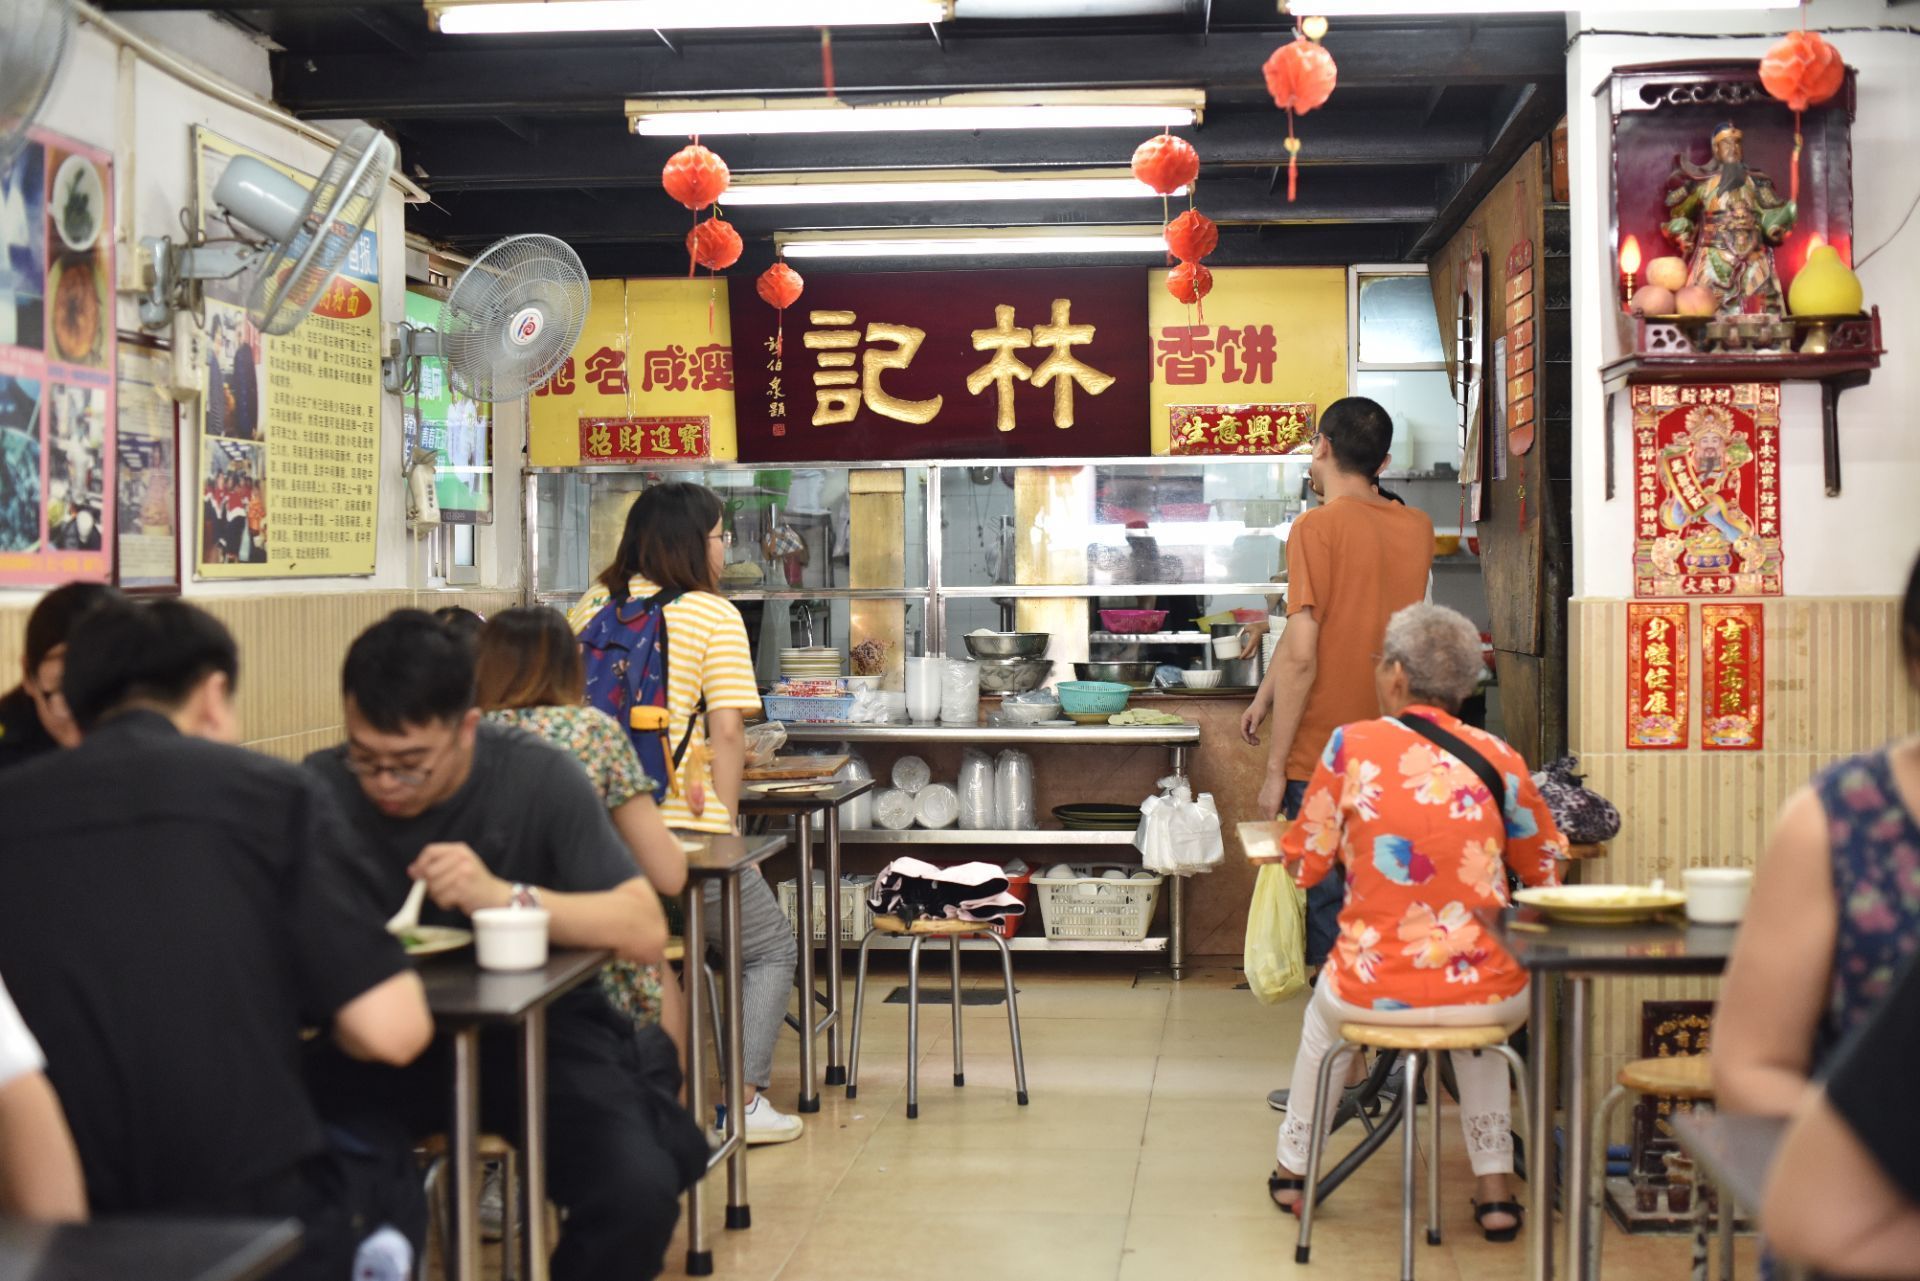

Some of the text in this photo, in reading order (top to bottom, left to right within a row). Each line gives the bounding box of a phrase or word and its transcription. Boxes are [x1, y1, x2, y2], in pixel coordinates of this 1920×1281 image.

[587, 424, 703, 456] 招財進寶
[1181, 414, 1306, 445] 生意興隆
[1643, 617, 1673, 713] 身體健康
[1716, 618, 1747, 715] 吉星高照
